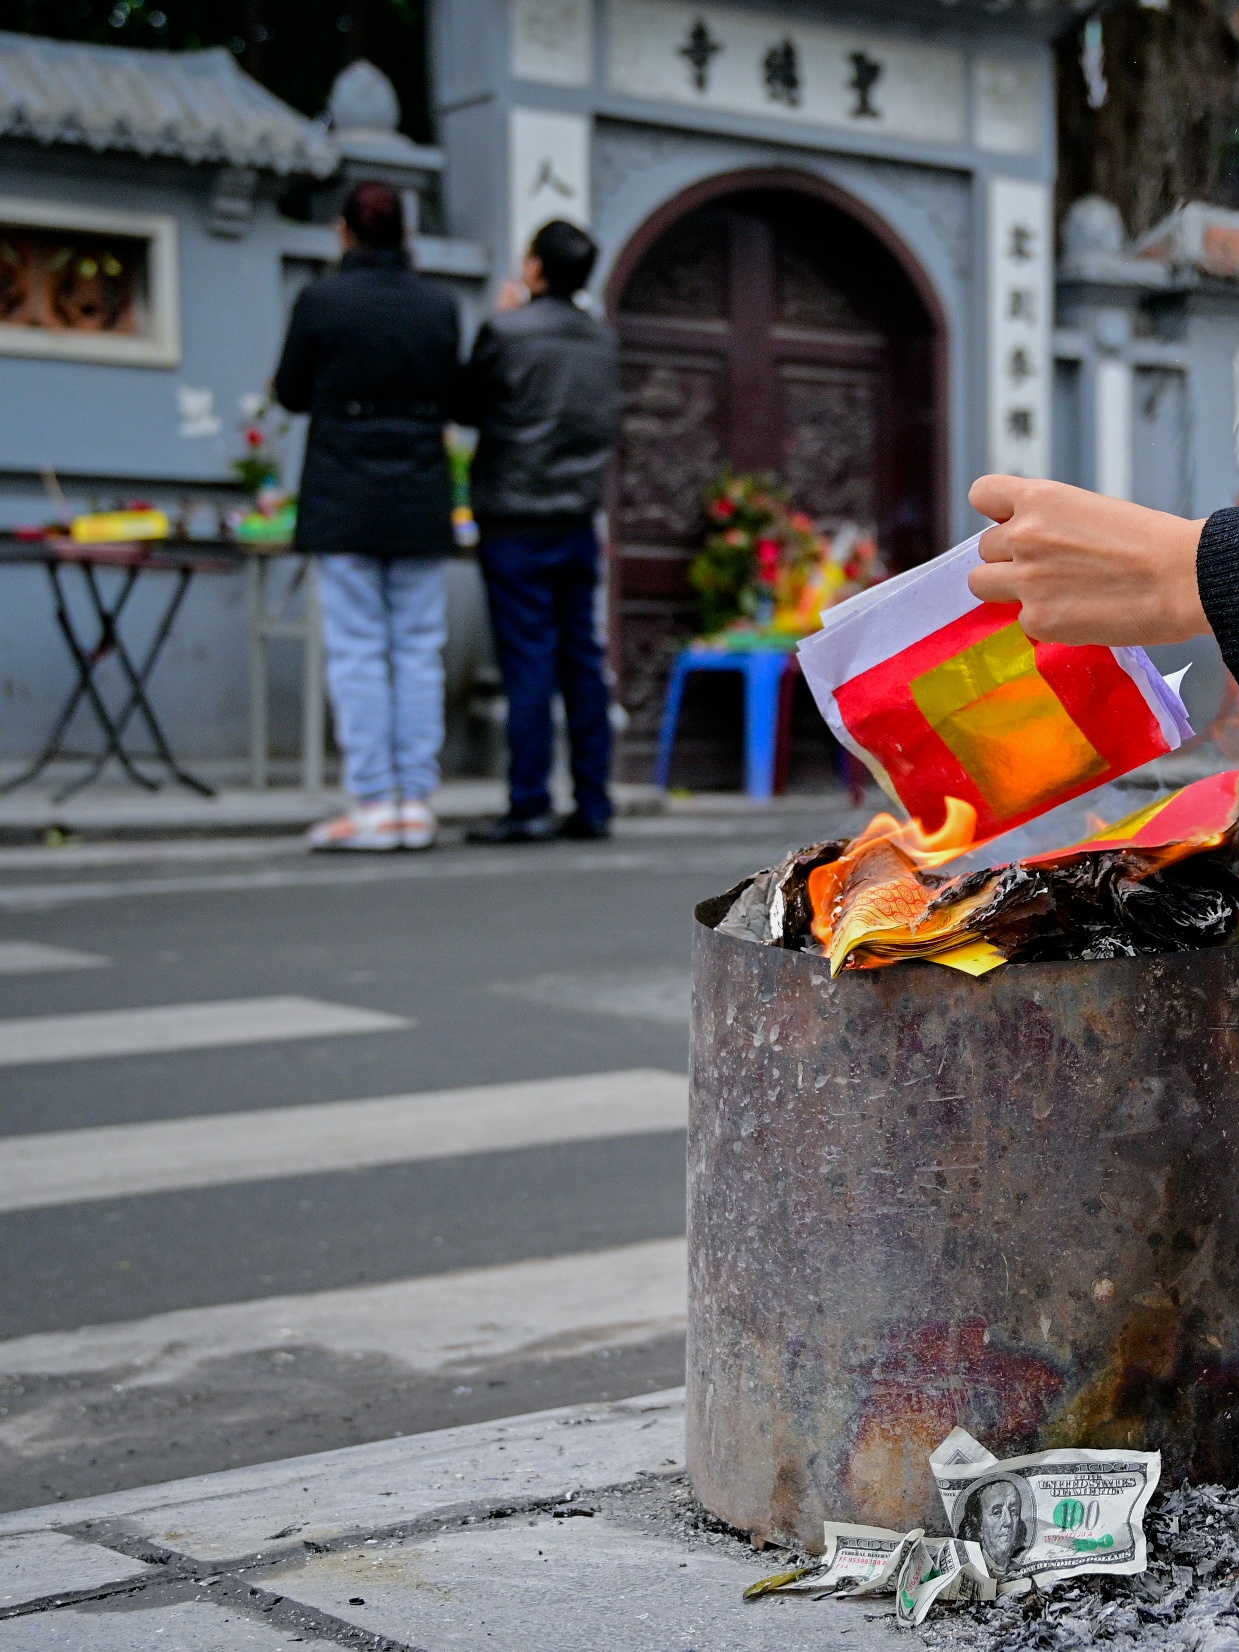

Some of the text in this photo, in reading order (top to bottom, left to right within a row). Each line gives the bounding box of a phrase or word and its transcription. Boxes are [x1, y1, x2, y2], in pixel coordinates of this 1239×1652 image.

[1038, 1477, 1137, 1489] UNITED STATES
[1050, 1487, 1125, 1497] OF AMERICA
[1060, 1500, 1100, 1532] 100
[1020, 1565, 1036, 1575] ONE
[1036, 1558, 1085, 1571] HUNDRED
[1084, 1551, 1132, 1563] DOLLARS
